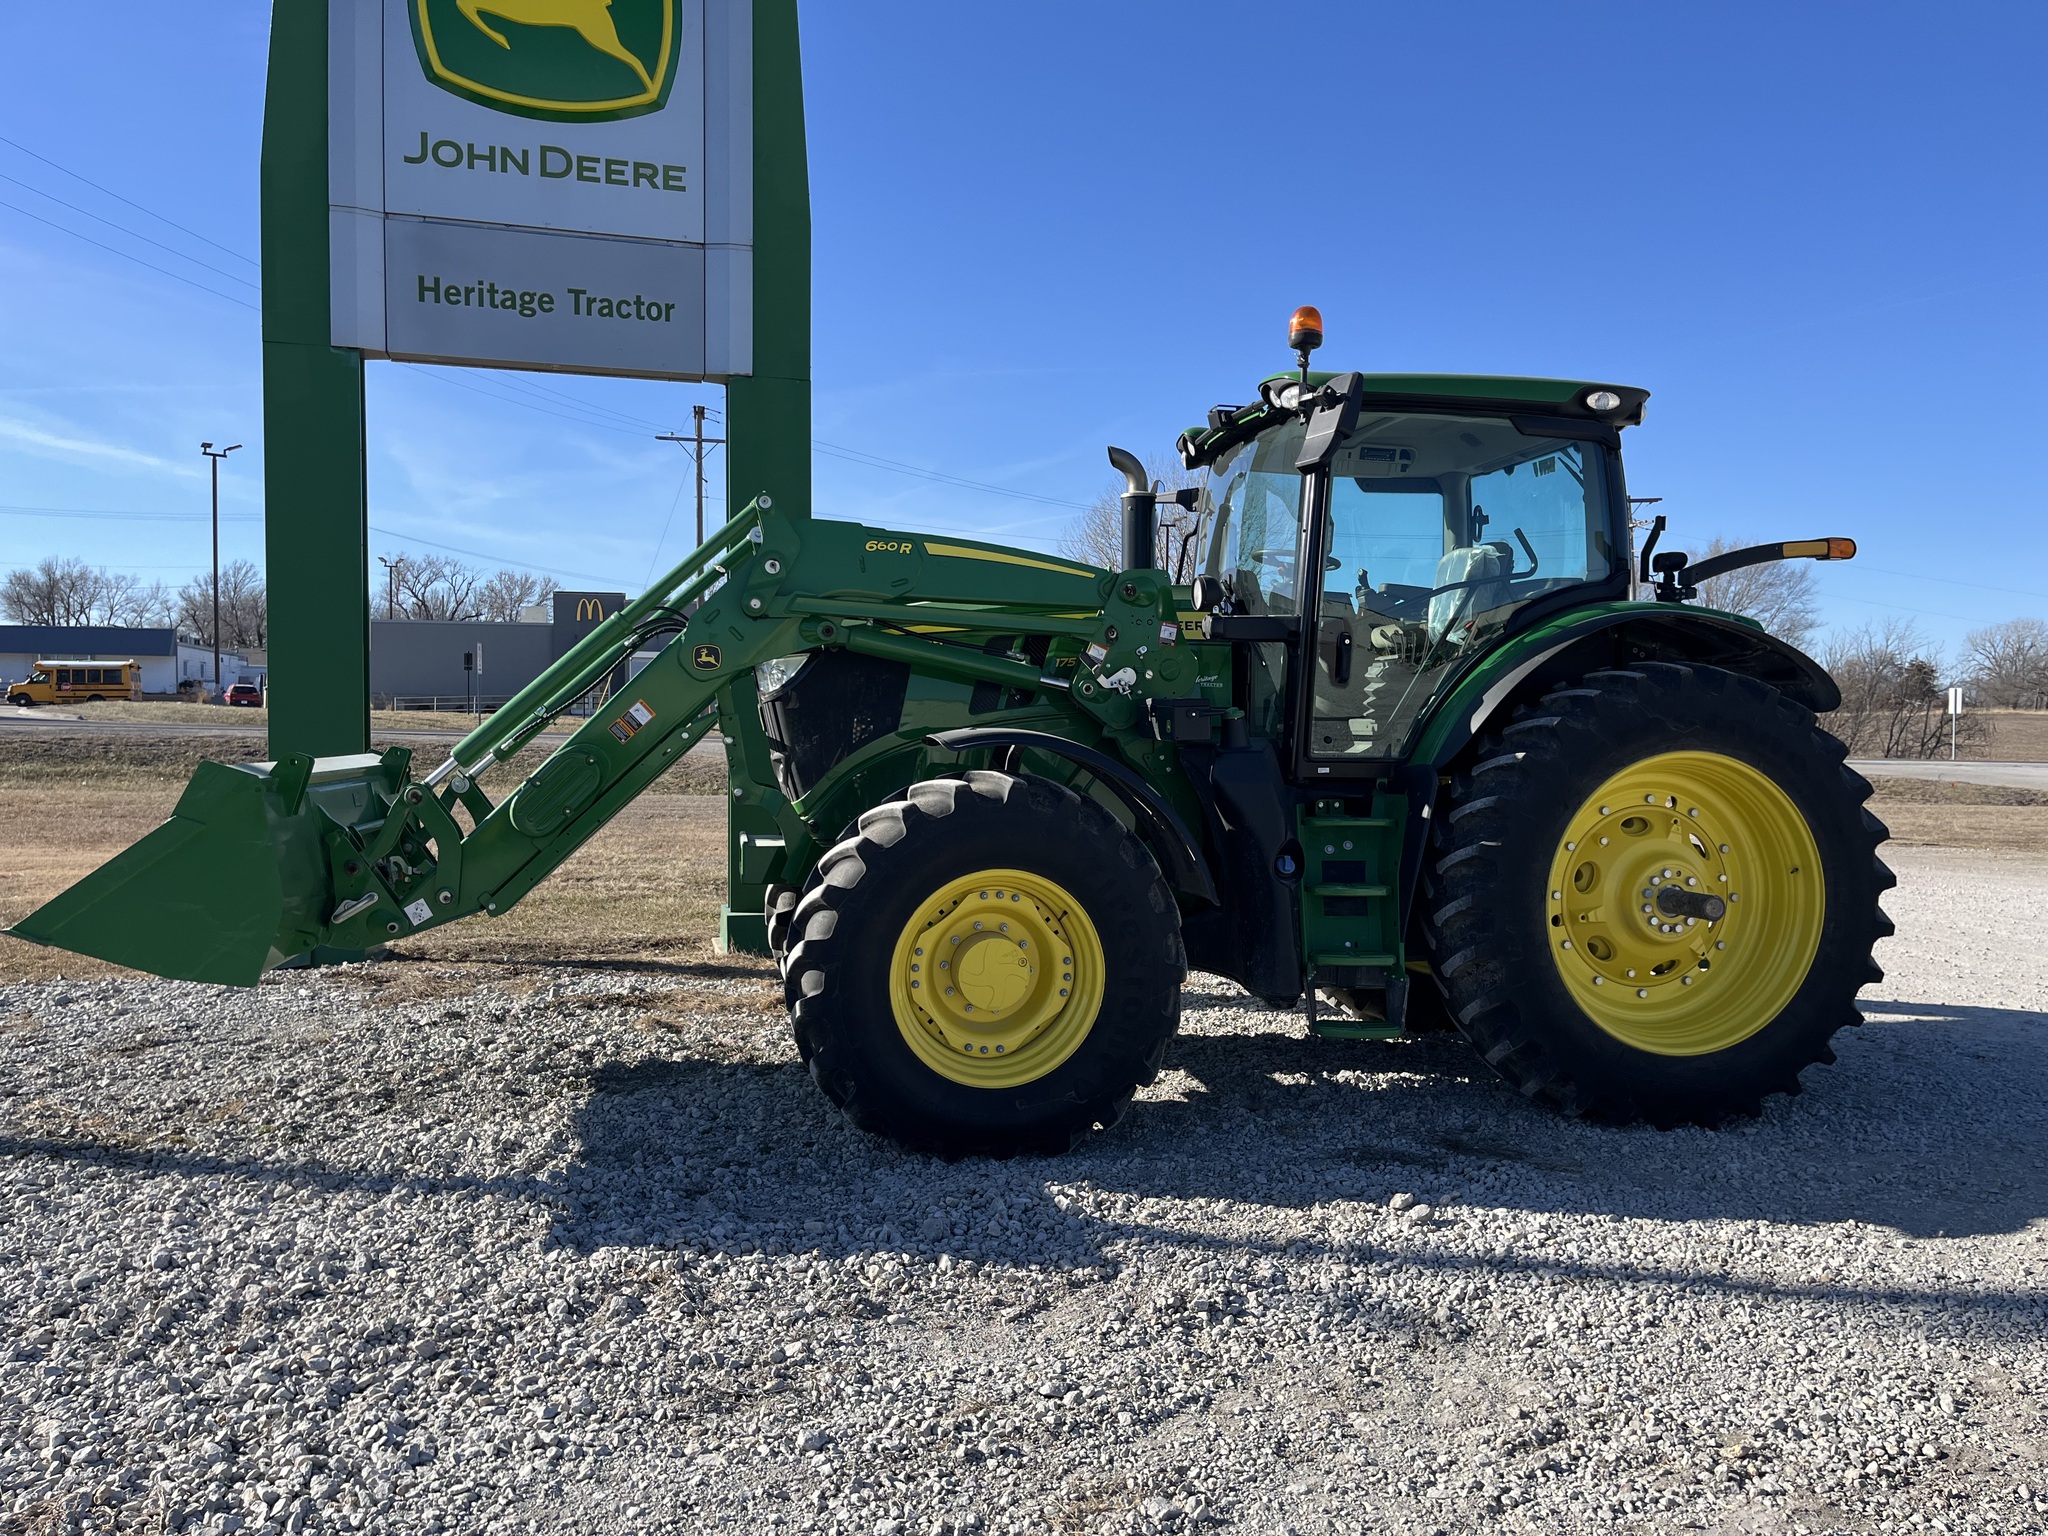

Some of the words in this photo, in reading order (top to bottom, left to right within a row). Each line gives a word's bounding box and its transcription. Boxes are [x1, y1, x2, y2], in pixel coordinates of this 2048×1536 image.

[403, 131, 530, 176] JOHN
[539, 144, 687, 193] DEERE
[417, 274, 555, 318] Heritage
[566, 287, 676, 323] Tractor
[1055, 657, 1077, 668] 175
